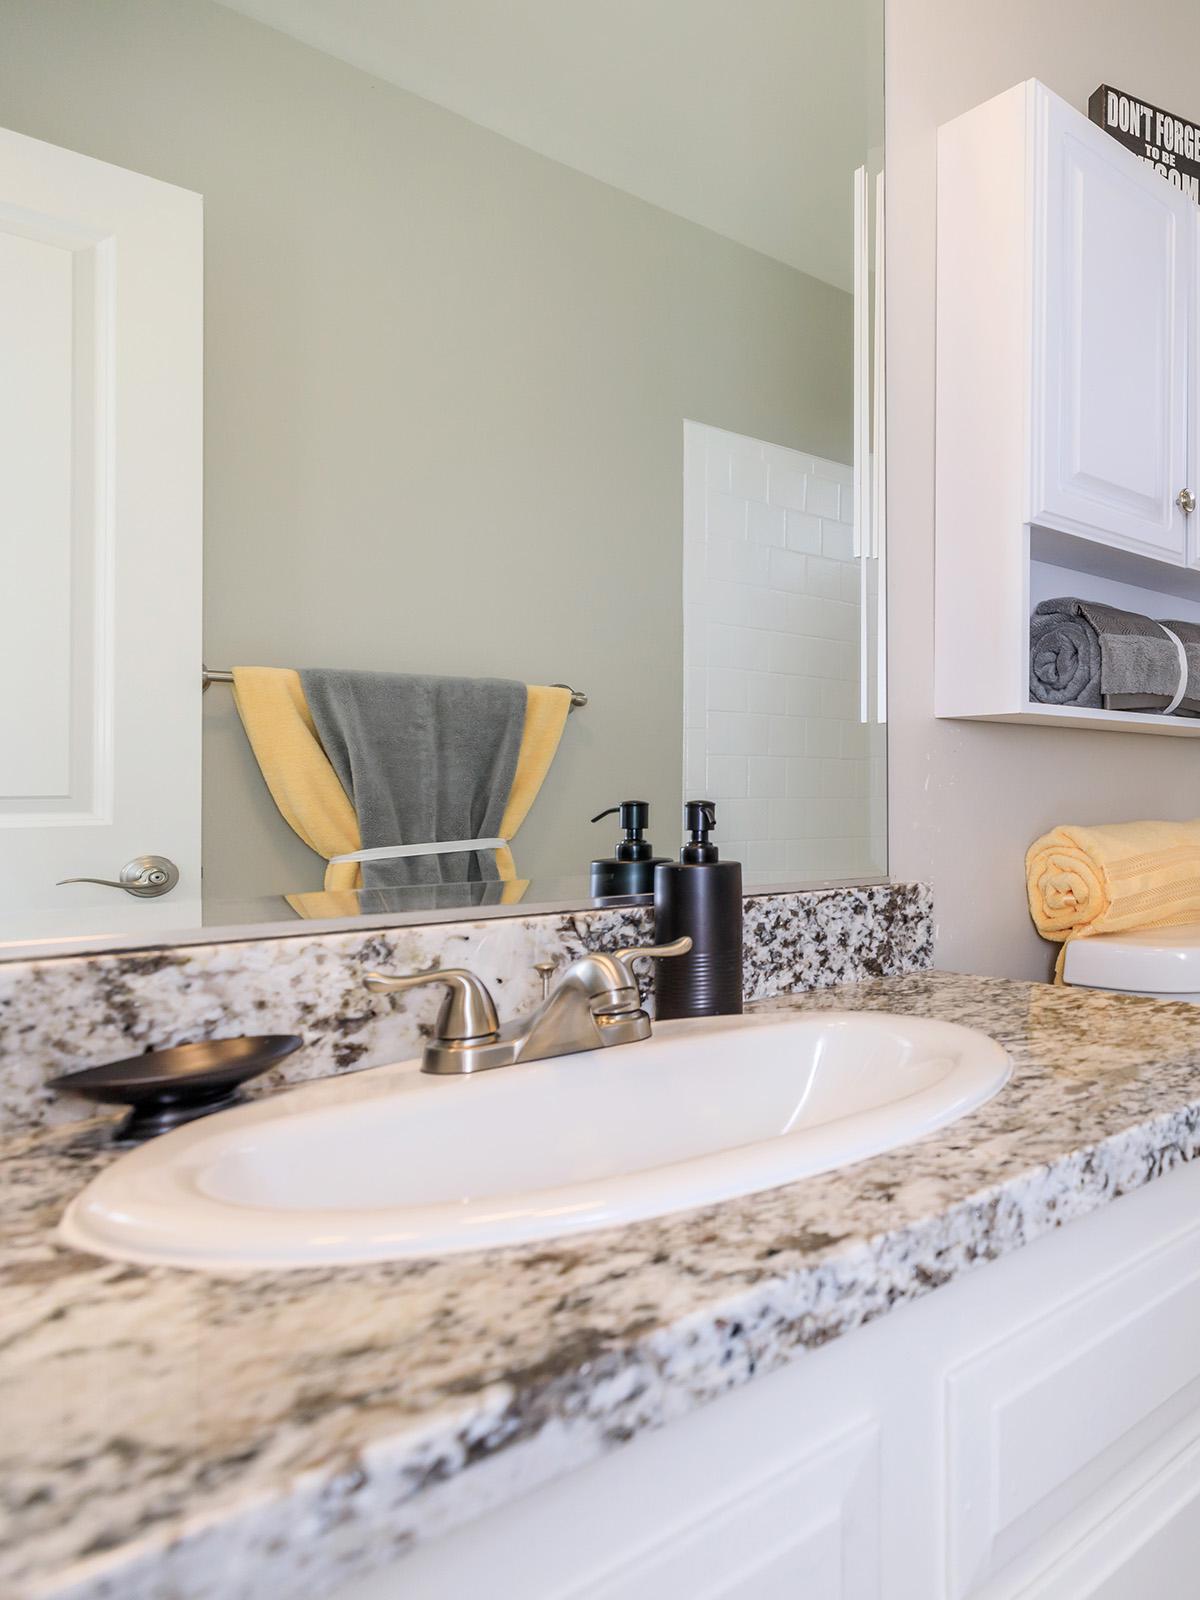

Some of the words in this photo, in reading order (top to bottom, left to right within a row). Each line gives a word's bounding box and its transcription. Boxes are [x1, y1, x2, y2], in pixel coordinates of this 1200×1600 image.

[1107, 90, 1153, 142] DON'T
[1145, 143, 1160, 160] TO
[1162, 150, 1176, 167] BE
